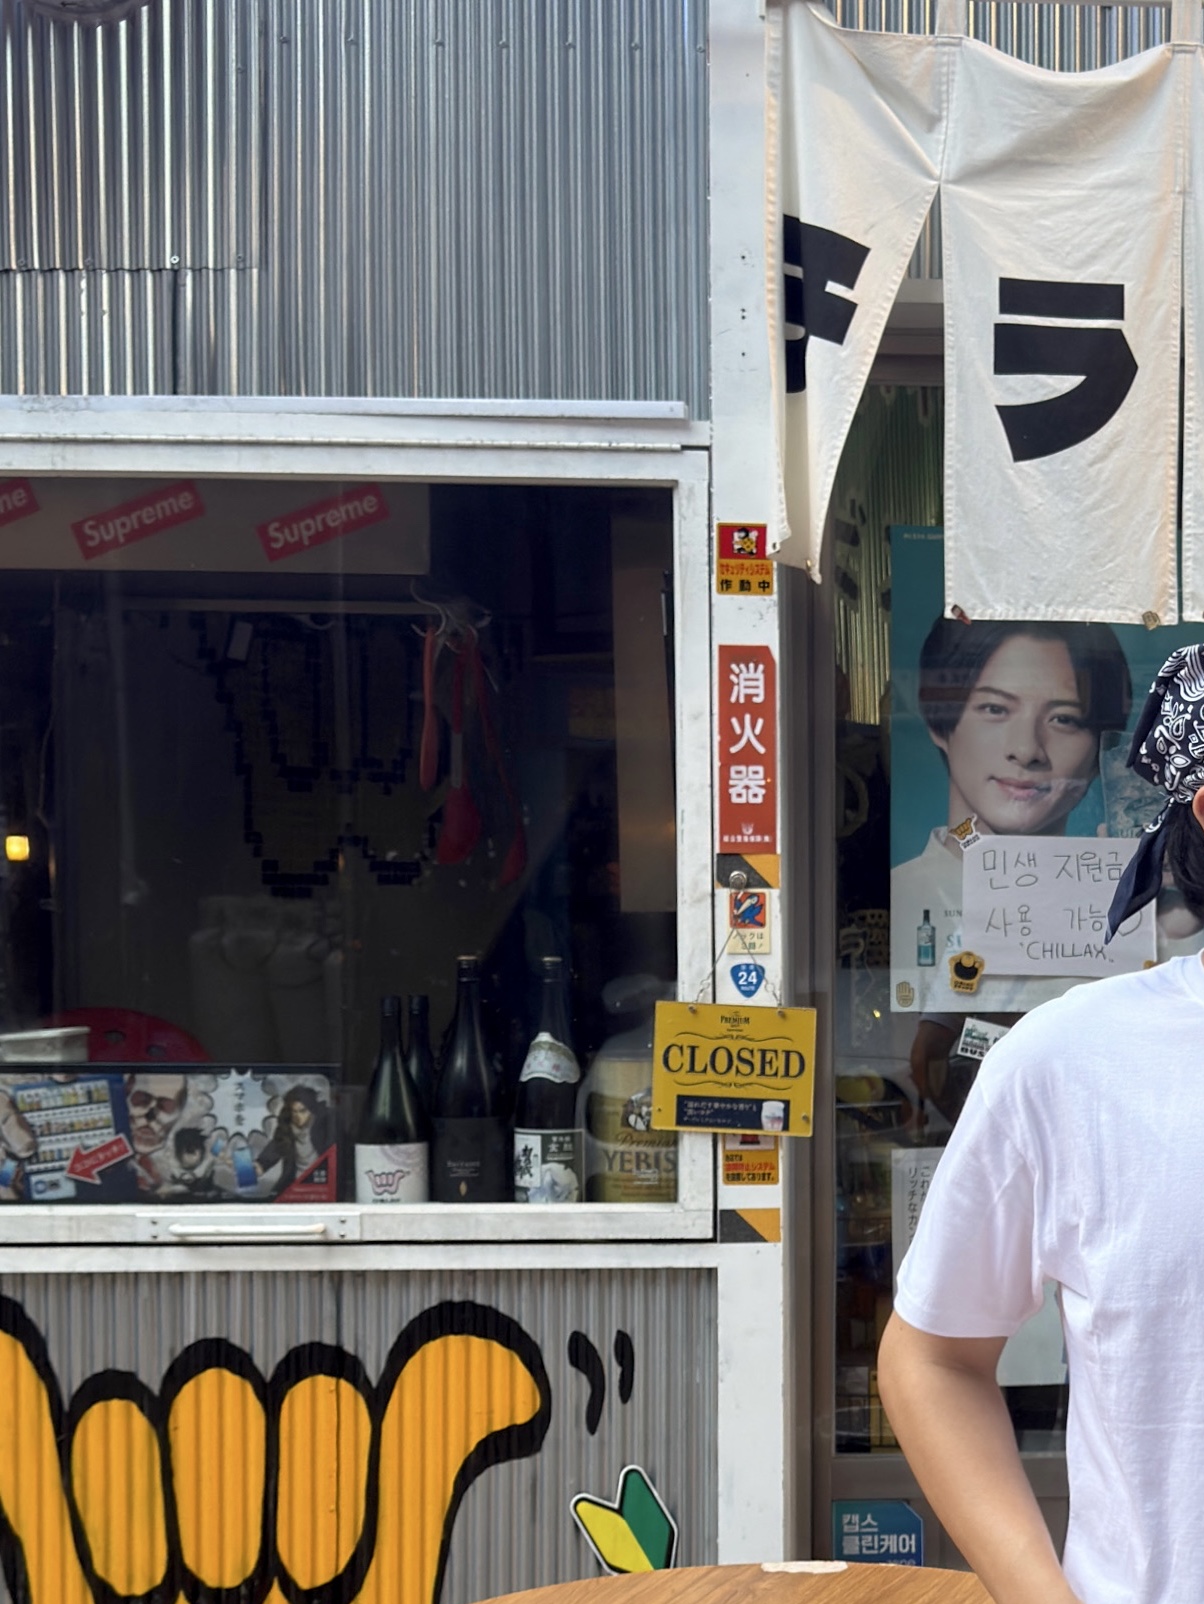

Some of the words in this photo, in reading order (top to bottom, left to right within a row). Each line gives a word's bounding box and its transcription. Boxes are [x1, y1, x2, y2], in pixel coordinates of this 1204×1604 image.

[82, 489, 194, 547] Supreme
[267, 493, 379, 549] Supreme
[720, 579, 770, 592] 作動中
[729, 661, 766, 804] 消火器
[982, 849, 1038, 890] 민생
[1053, 851, 1123, 883] 지원금
[985, 904, 1032, 937] 사용
[1063, 904, 1107, 932] 가능
[738, 971, 758, 985] 24
[662, 1043, 806, 1080] CLOSED
[842, 1513, 879, 1533] 캡스
[842, 1533, 917, 1556] 클린케어
